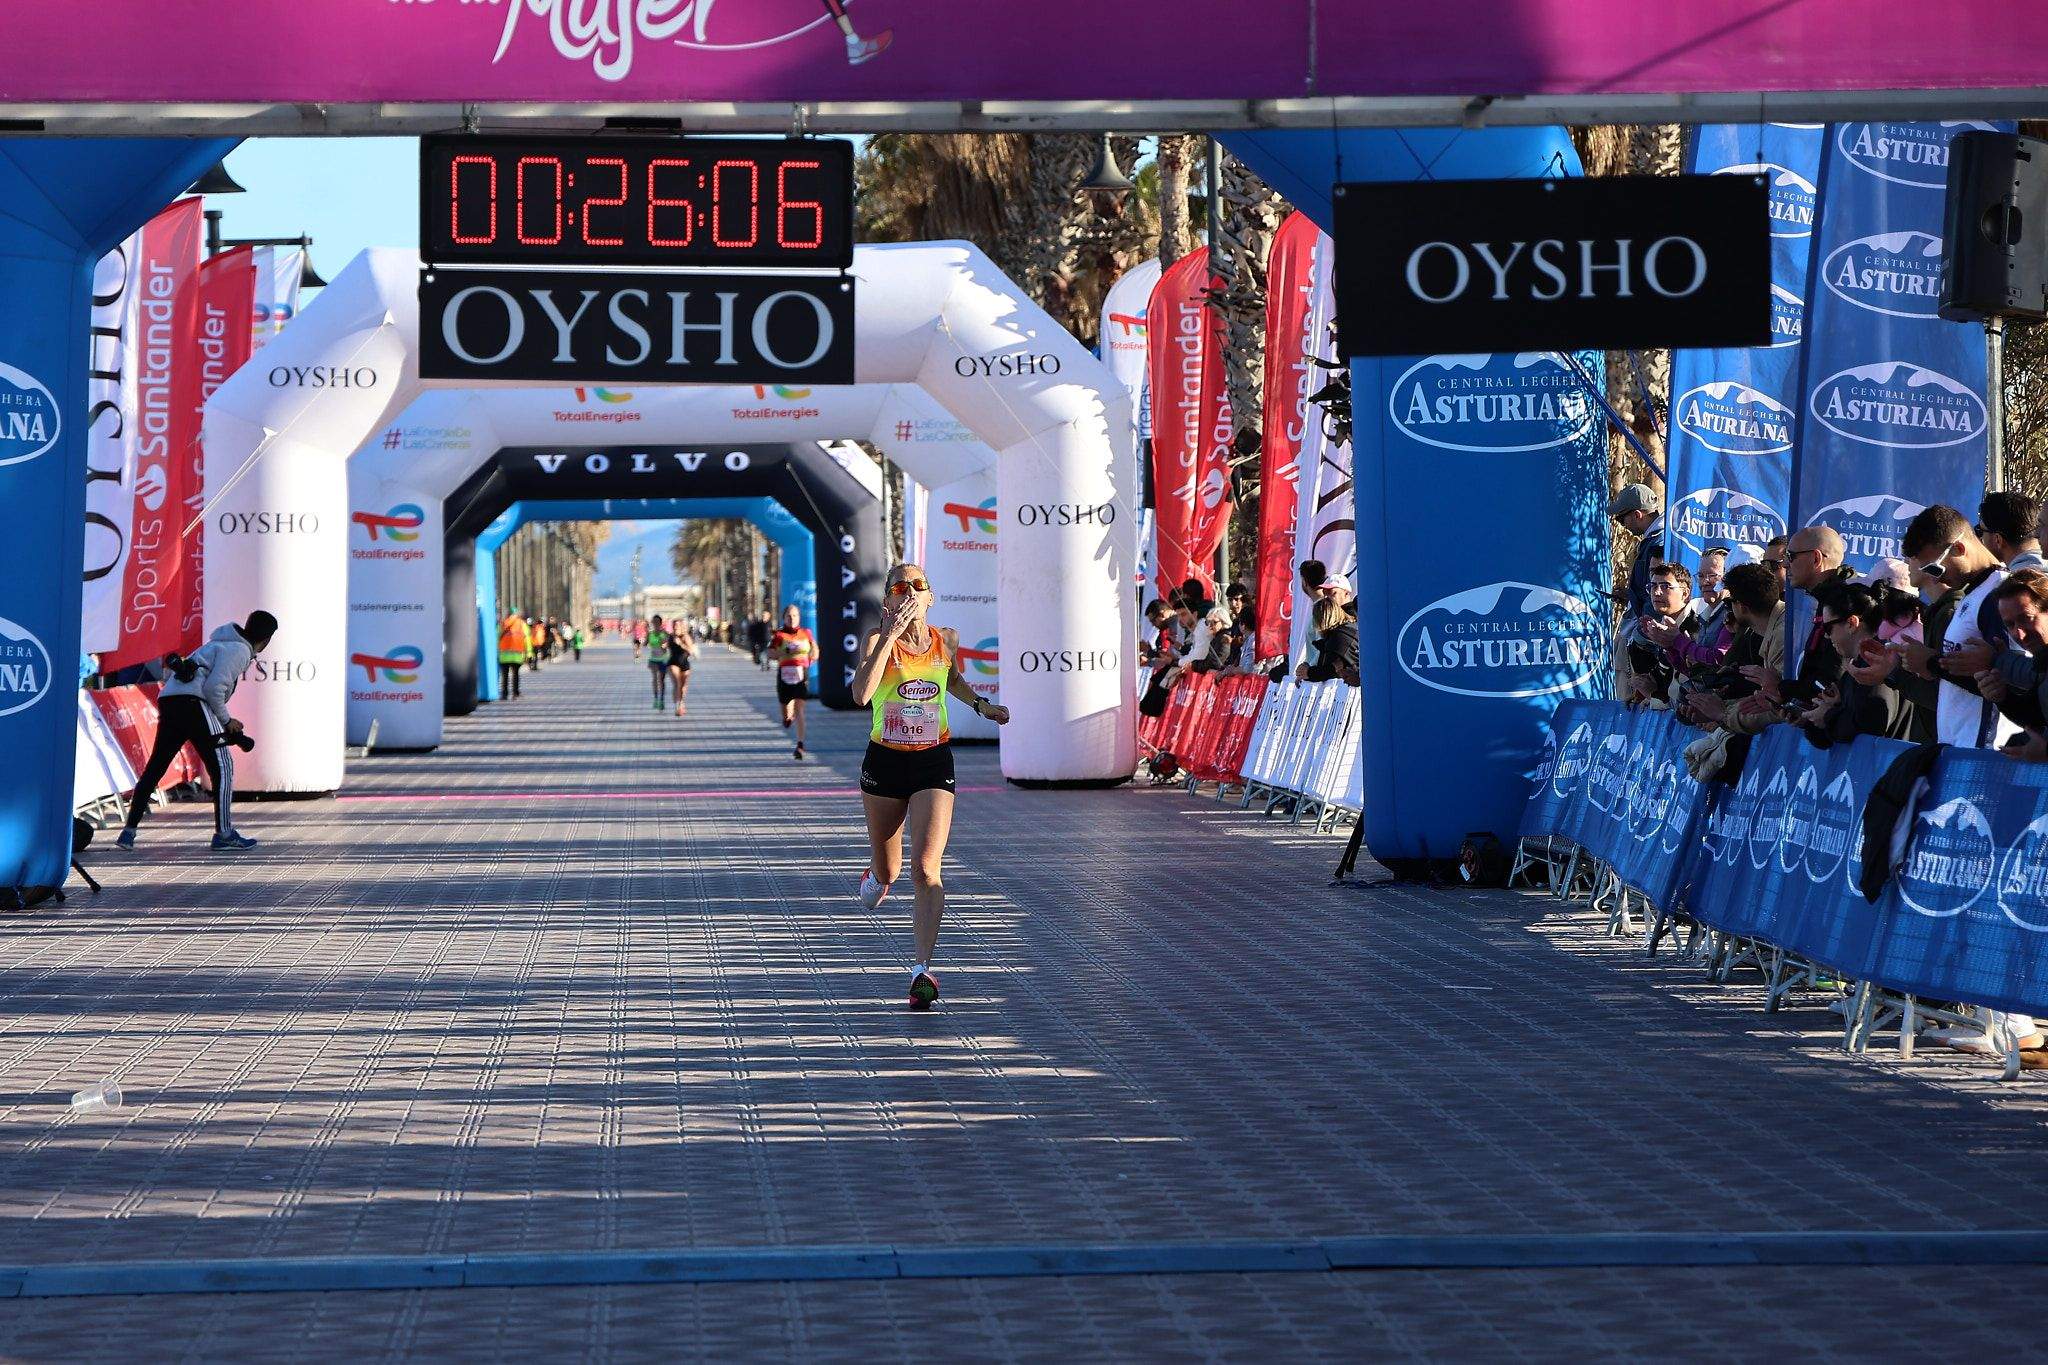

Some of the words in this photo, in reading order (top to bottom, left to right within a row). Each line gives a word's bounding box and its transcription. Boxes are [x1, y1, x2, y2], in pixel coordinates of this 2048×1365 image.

[1881, 124, 1937, 140] CENTRAL
[451, 155, 823, 249] 00:26:06
[1406, 236, 1708, 304] OYSHO
[1864, 255, 1921, 270] CENTRAL
[1835, 255, 1940, 297] ASTURI
[441, 285, 835, 370] OYSHO
[137, 259, 175, 458] Santander
[955, 354, 1061, 377] OYSHO
[269, 366, 377, 388] OYSHO
[1175, 302, 1203, 468] Santander
[1438, 376, 1514, 390] CENTRAL
[1851, 386, 1905, 400] CENTRAL
[1911, 393, 1970, 407] LECHERA
[553, 410, 641, 423] TotalEnergies
[732, 406, 819, 419] TotalEnergies
[1823, 386, 1973, 433] ASTURIANA
[535, 451, 750, 474] VOLVO
[219, 512, 319, 535] OYSHO
[1018, 502, 1116, 526] OYSHO
[1840, 520, 1892, 533] CENTRAL
[352, 549, 425, 561] TotalEnergies
[125, 519, 166, 635] Sports
[840, 534, 859, 688] VOLVO
[1444, 621, 1521, 635] CENTRAL
[1411, 626, 1599, 669] ASTURIANA
[1020, 650, 1118, 673] OYSHO
[351, 691, 424, 702] TotalEnergies
[901, 684, 937, 696] Serrano
[901, 725, 924, 735] 016
